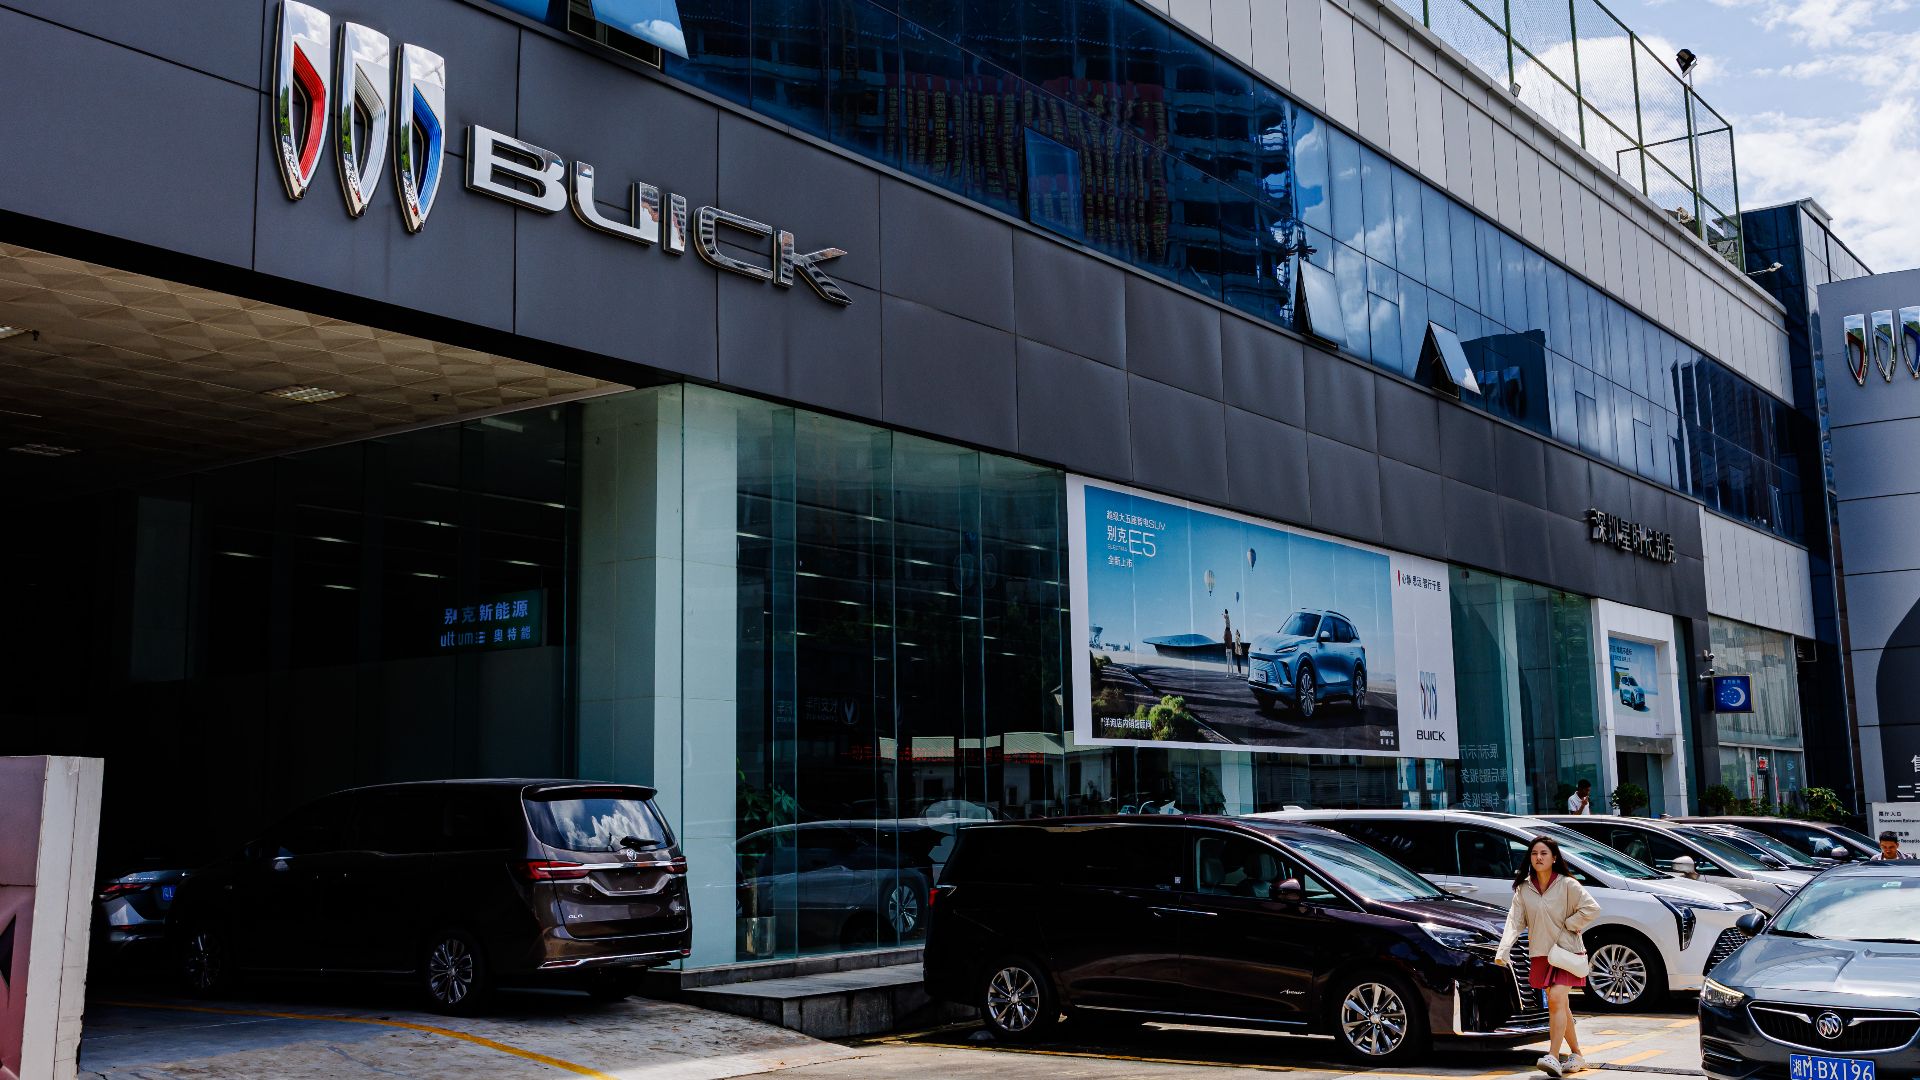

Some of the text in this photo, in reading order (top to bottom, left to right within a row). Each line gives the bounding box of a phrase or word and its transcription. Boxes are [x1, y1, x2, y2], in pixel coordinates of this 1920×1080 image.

[466, 124, 853, 306] BUICK
[1107, 525, 1156, 557] 别克 E5
[1107, 555, 1132, 568] 全新上市
[444, 600, 528, 625] 别克新能源
[1416, 729, 1446, 741] BUICK
